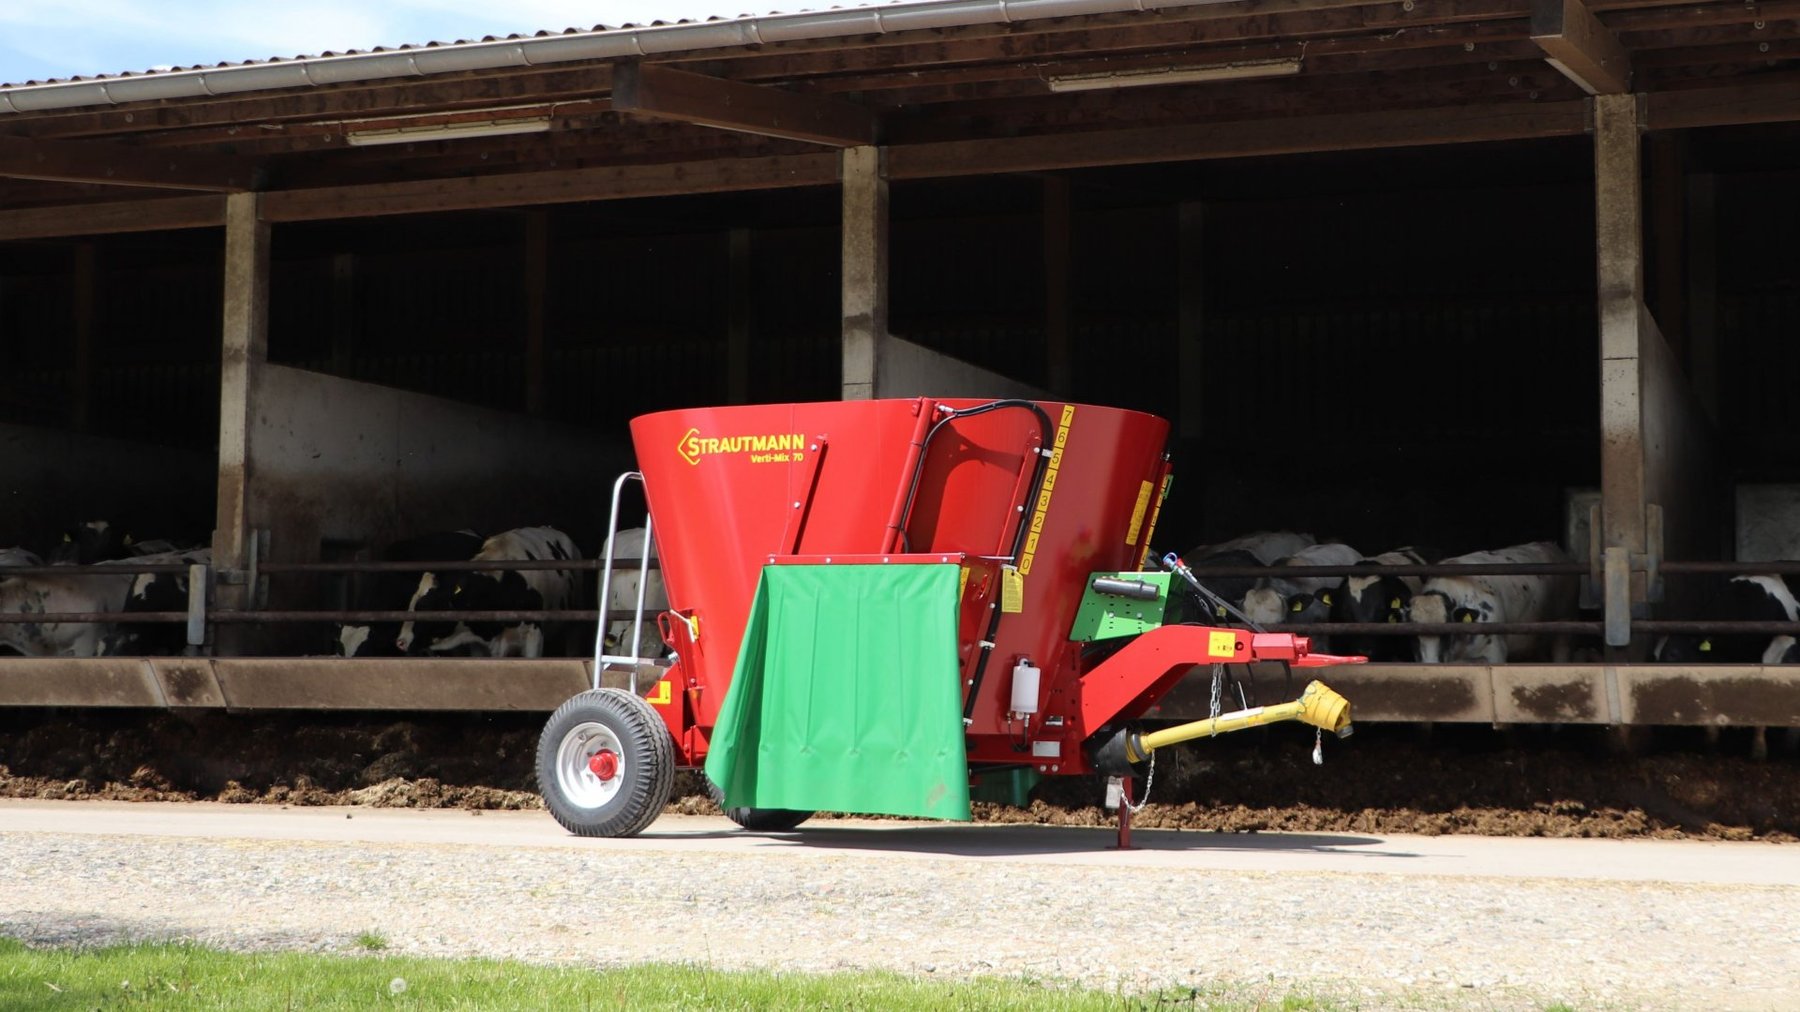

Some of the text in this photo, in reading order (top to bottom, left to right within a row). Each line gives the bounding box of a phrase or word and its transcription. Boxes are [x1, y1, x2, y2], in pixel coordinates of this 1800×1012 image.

[1064, 409, 1072, 422] 7
[1057, 431, 1066, 443] 6
[687, 434, 805, 457] STRAUTMANN
[751, 452, 804, 463] Verti-Mix 70
[1051, 452, 1060, 465] 5
[1046, 474, 1054, 486] 4
[1040, 495, 1048, 507] 3
[1033, 516, 1042, 528] 2
[1029, 538, 1036, 549] 1
[1022, 558, 1030, 570] 0
